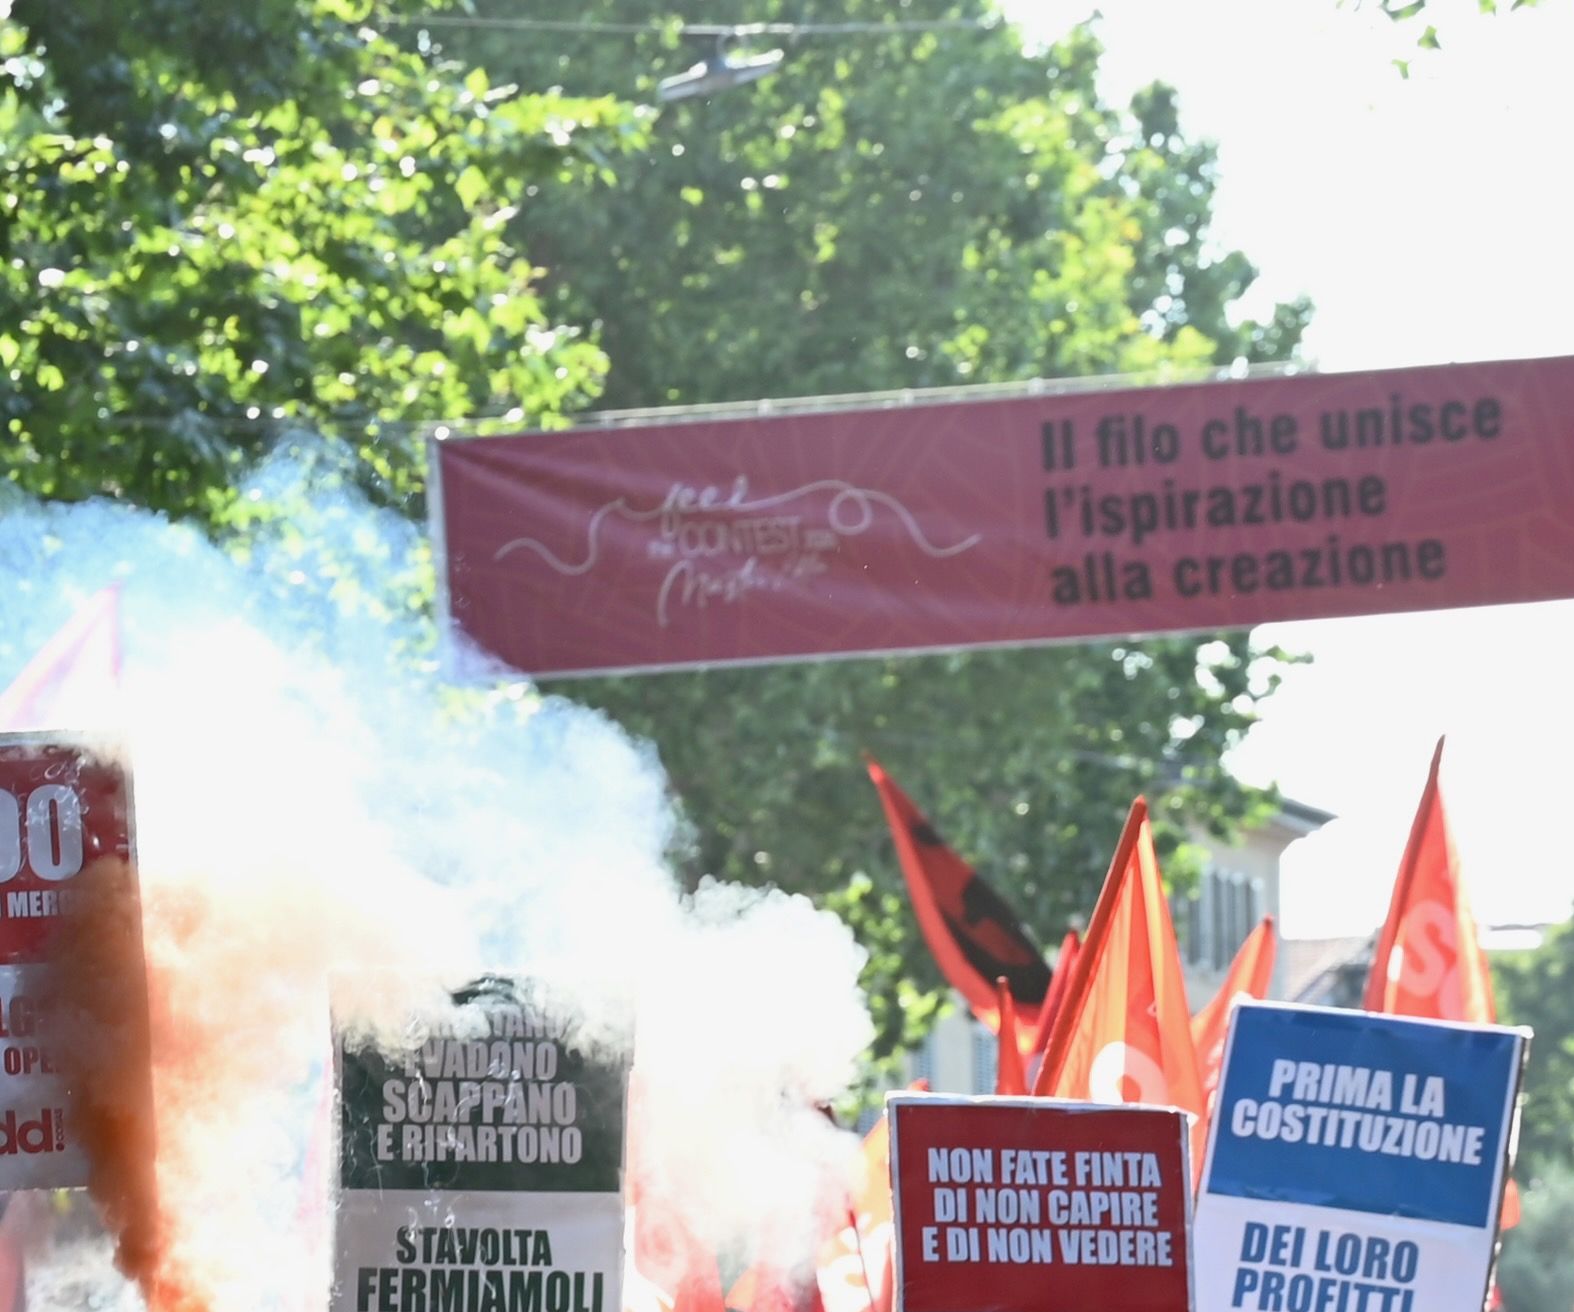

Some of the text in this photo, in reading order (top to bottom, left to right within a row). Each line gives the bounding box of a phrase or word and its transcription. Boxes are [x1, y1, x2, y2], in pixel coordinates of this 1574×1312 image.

[1096, 414, 1180, 468] filo
[1202, 406, 1297, 462] che
[1320, 394, 1502, 451] unisce
[1045, 472, 1386, 544] l'ispirazione
[1052, 536, 1445, 607] alla creazione
[382, 1079, 577, 1125] SCAPPANO
[1268, 1057, 1446, 1119] PRIMA LA
[377, 1124, 583, 1164] E RIPARTONO
[1231, 1098, 1486, 1166] COSTITUZIONE
[927, 1147, 1162, 1188] NON FATE FINTA
[933, 1188, 1160, 1227] DI NON CAPIRE
[395, 1226, 553, 1267] STAVOLTA
[922, 1226, 1173, 1267] E DI NON VEDERE
[1239, 1221, 1420, 1284] DEI LORO
